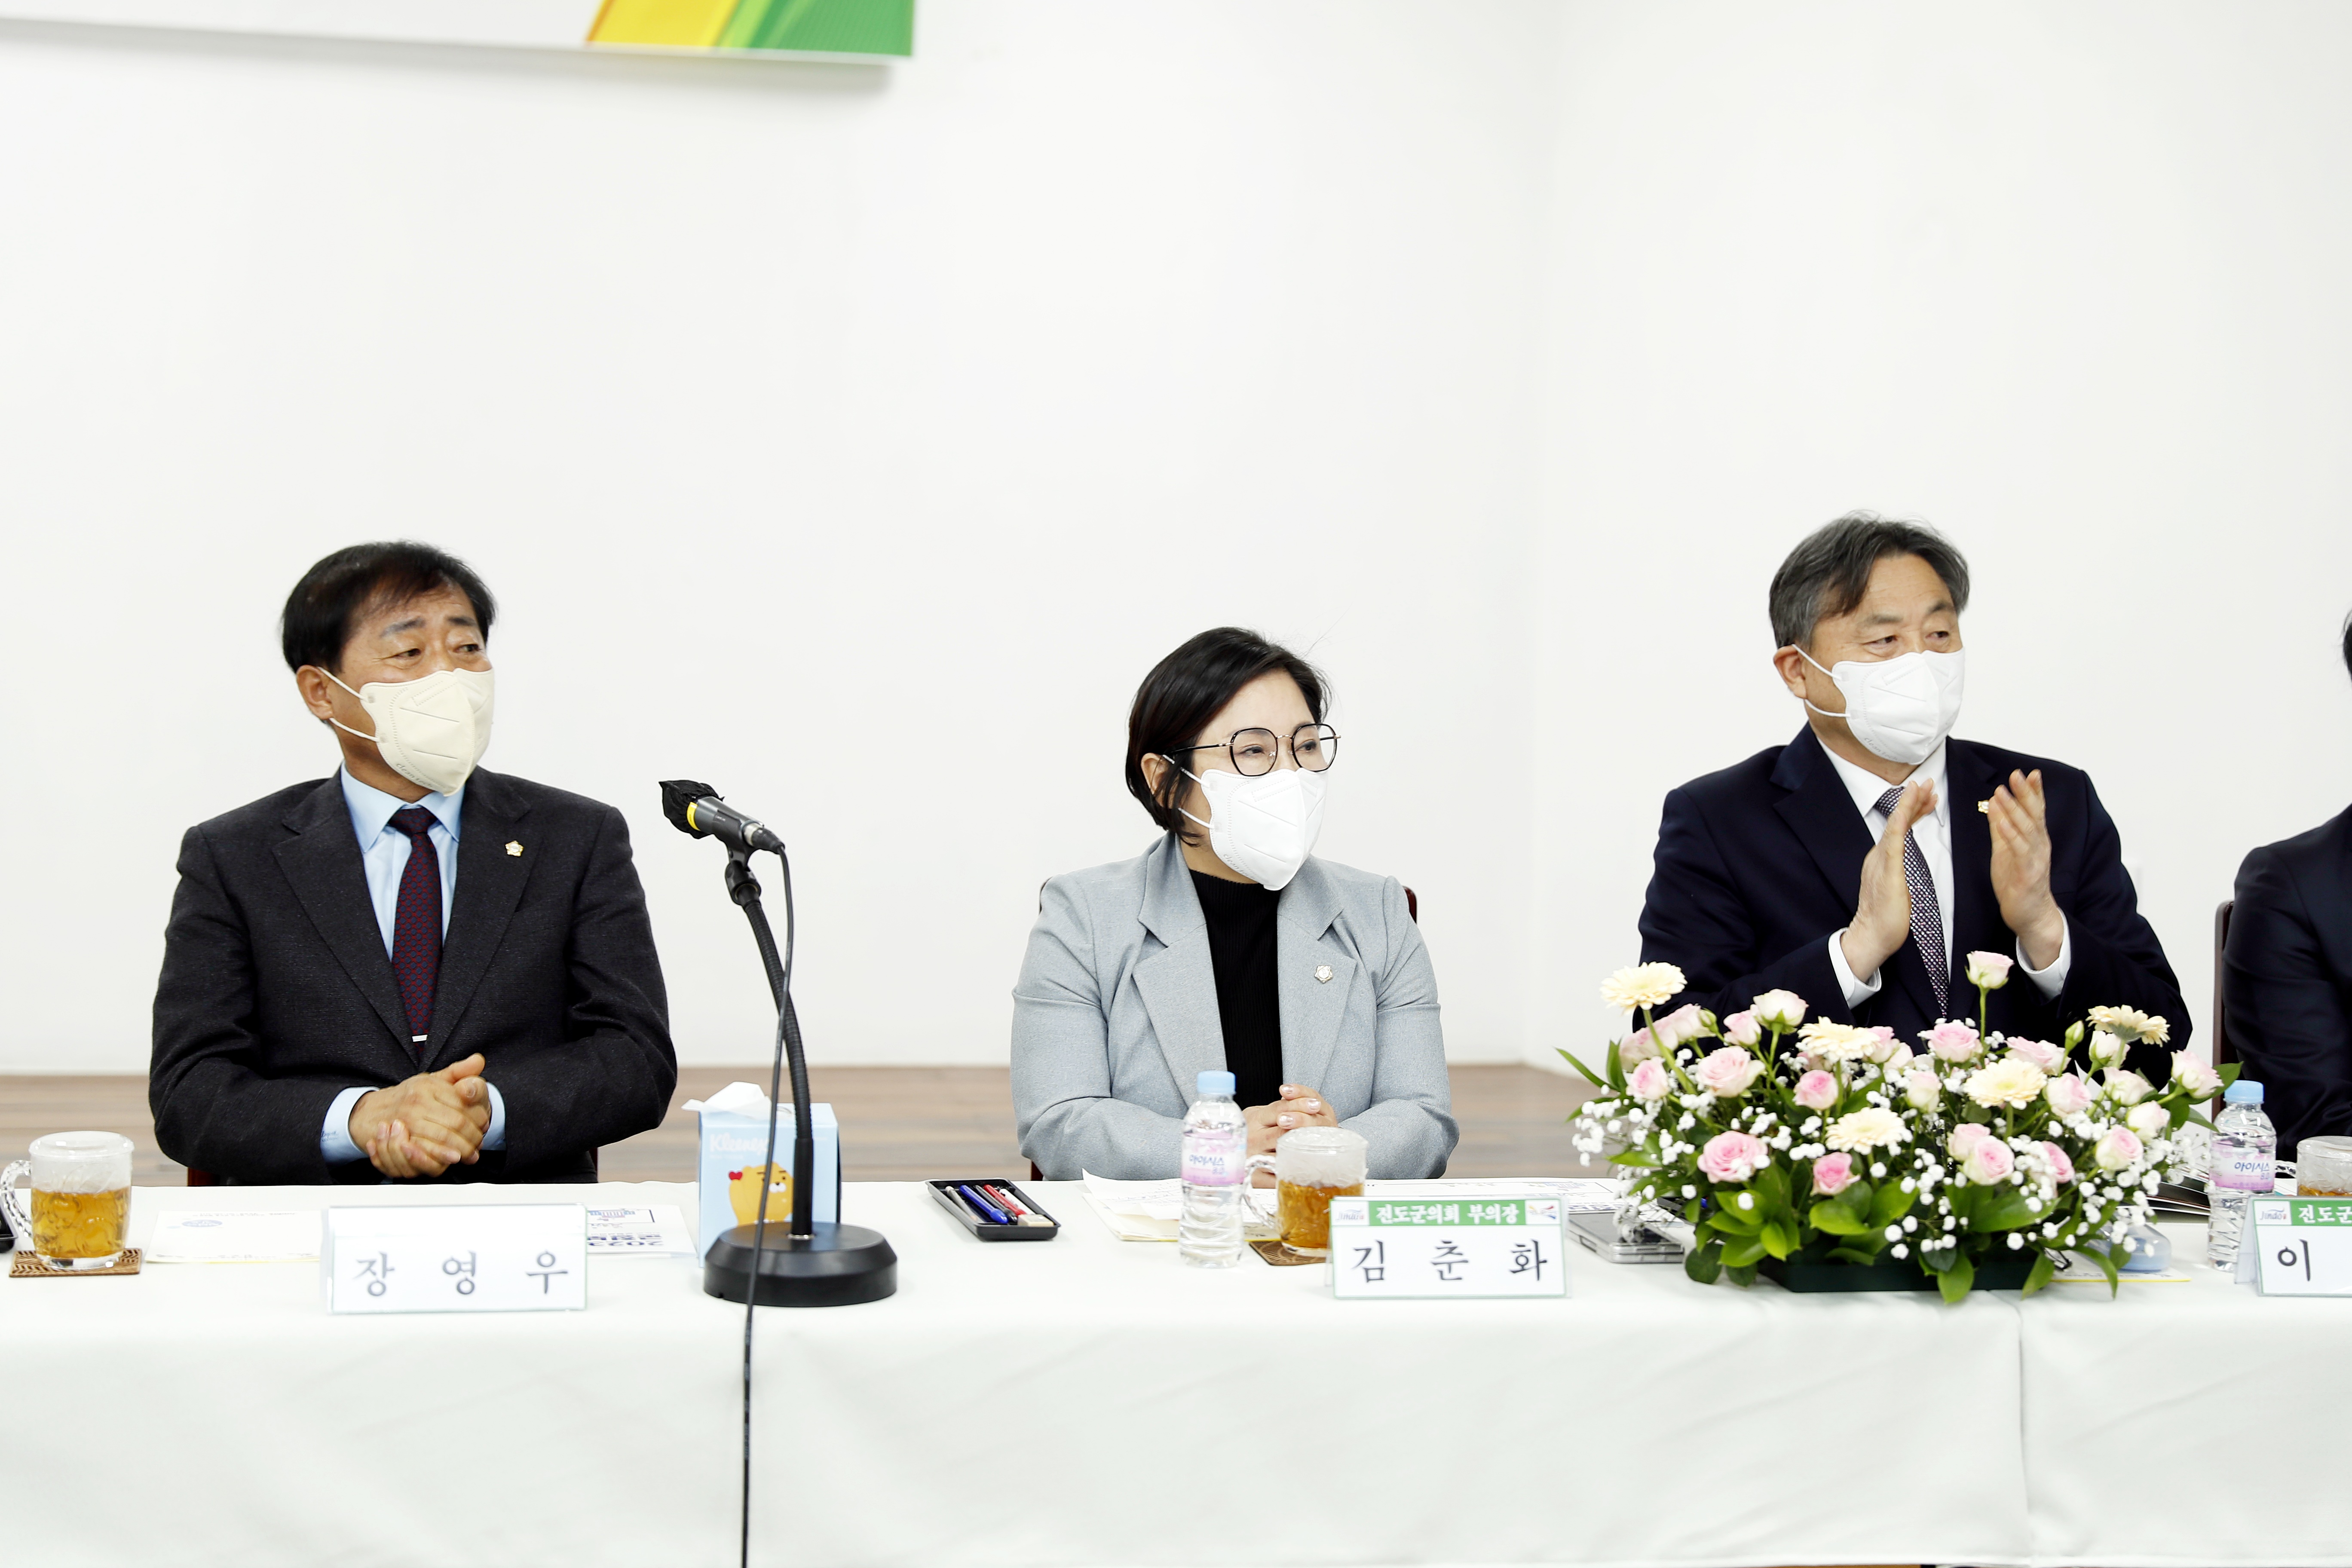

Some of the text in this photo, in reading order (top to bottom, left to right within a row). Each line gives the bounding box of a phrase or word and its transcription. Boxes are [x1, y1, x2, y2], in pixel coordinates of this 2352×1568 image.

[1864, 737, 1881, 752] clean
[396, 763, 415, 778] clean
[1223, 854, 1239, 869] clean
[1188, 1154, 1225, 1166] 아이시스
[2234, 1162, 2270, 1172] 아이시스
[1376, 1203, 1520, 1225] 진도군의회 부의장
[2277, 1238, 2311, 1282] 이
